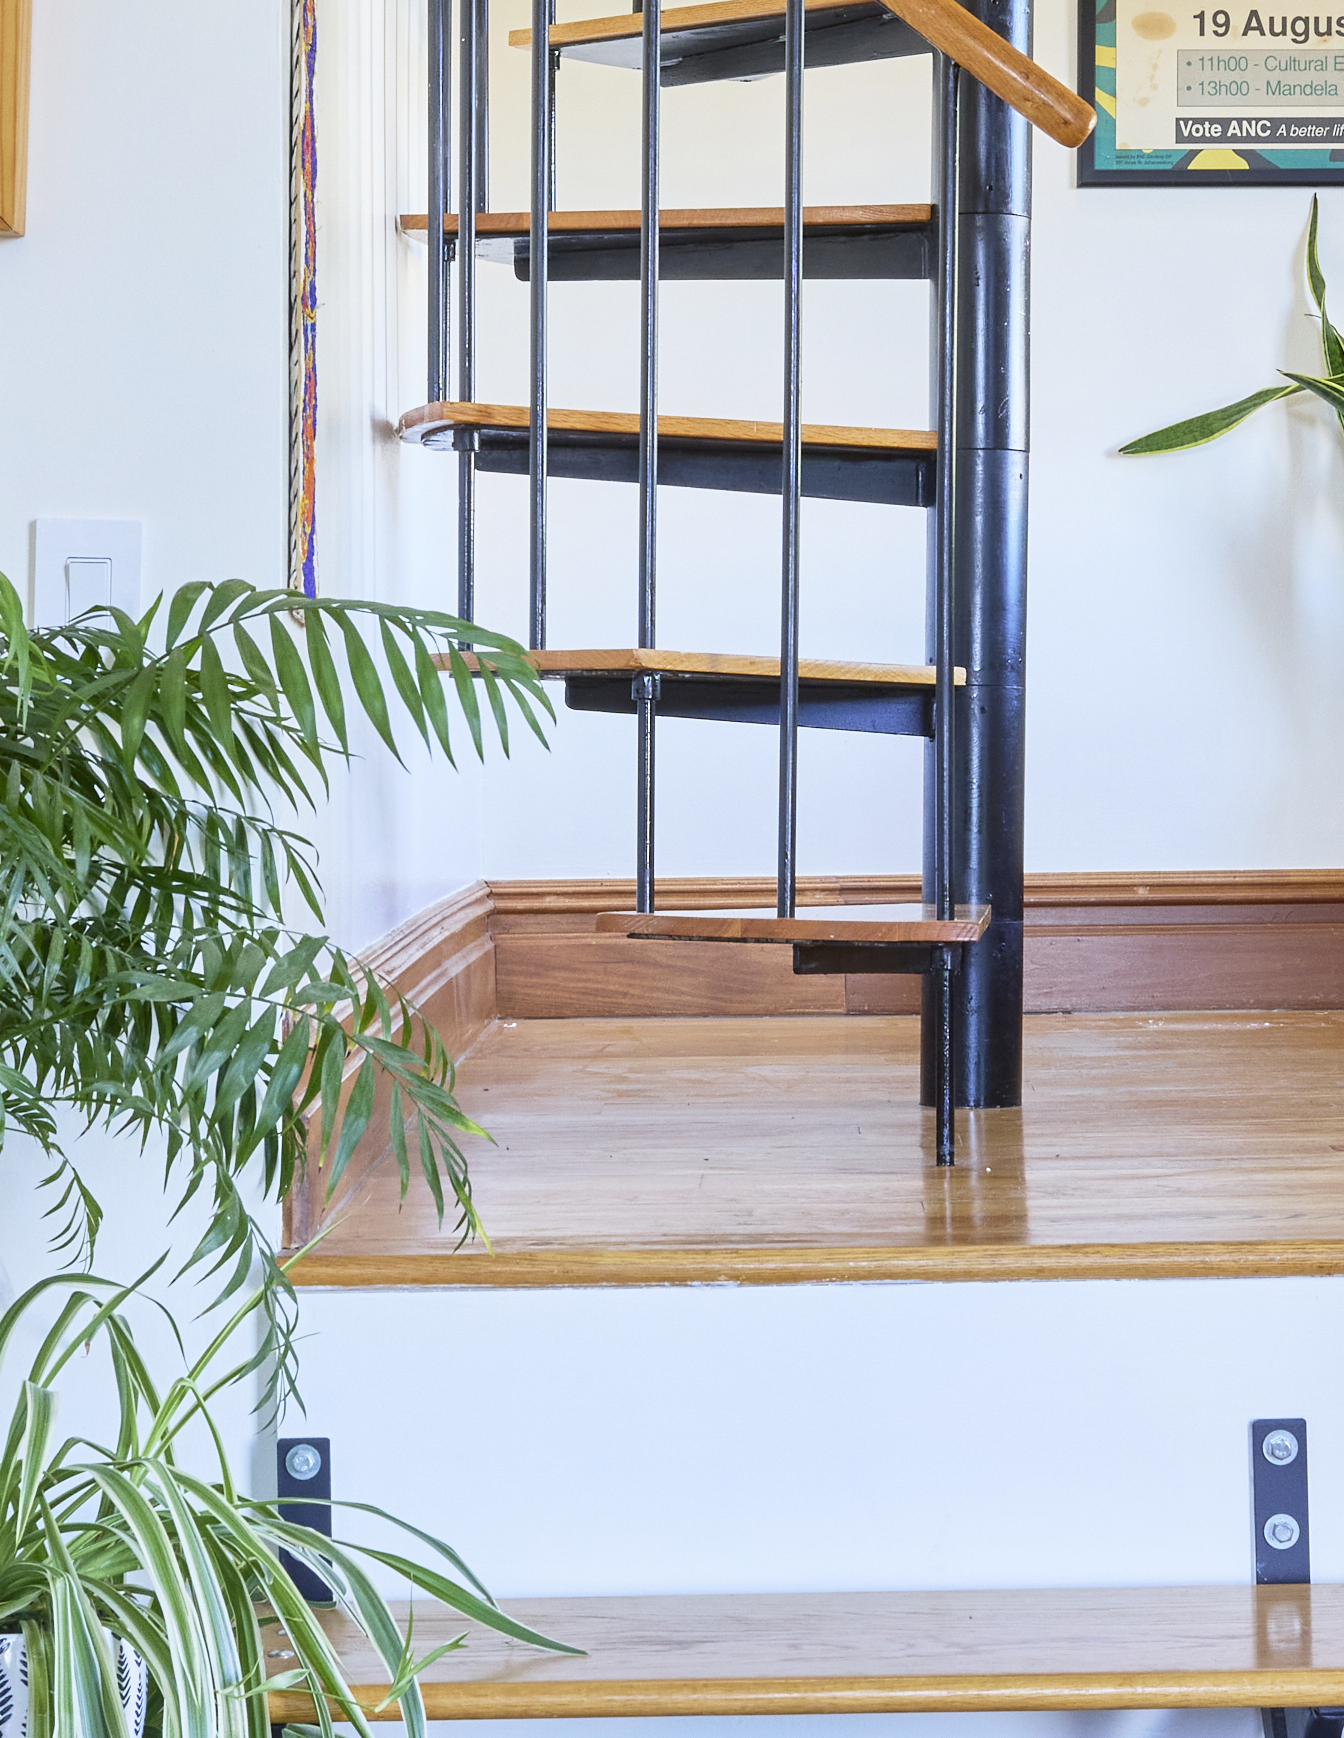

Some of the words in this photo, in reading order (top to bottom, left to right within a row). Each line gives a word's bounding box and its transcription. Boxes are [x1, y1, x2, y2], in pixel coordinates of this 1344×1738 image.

[1193, 10, 1230, 37] 19
[1198, 57, 1248, 72] 11h00
[1264, 56, 1328, 72] Cultural
[1198, 81, 1249, 96] 13h00
[1266, 80, 1338, 96] Mandela
[1180, 121, 1222, 138] Vote
[1227, 120, 1271, 138] ANC
[1276, 125, 1286, 137] A
[1290, 124, 1329, 137] better
